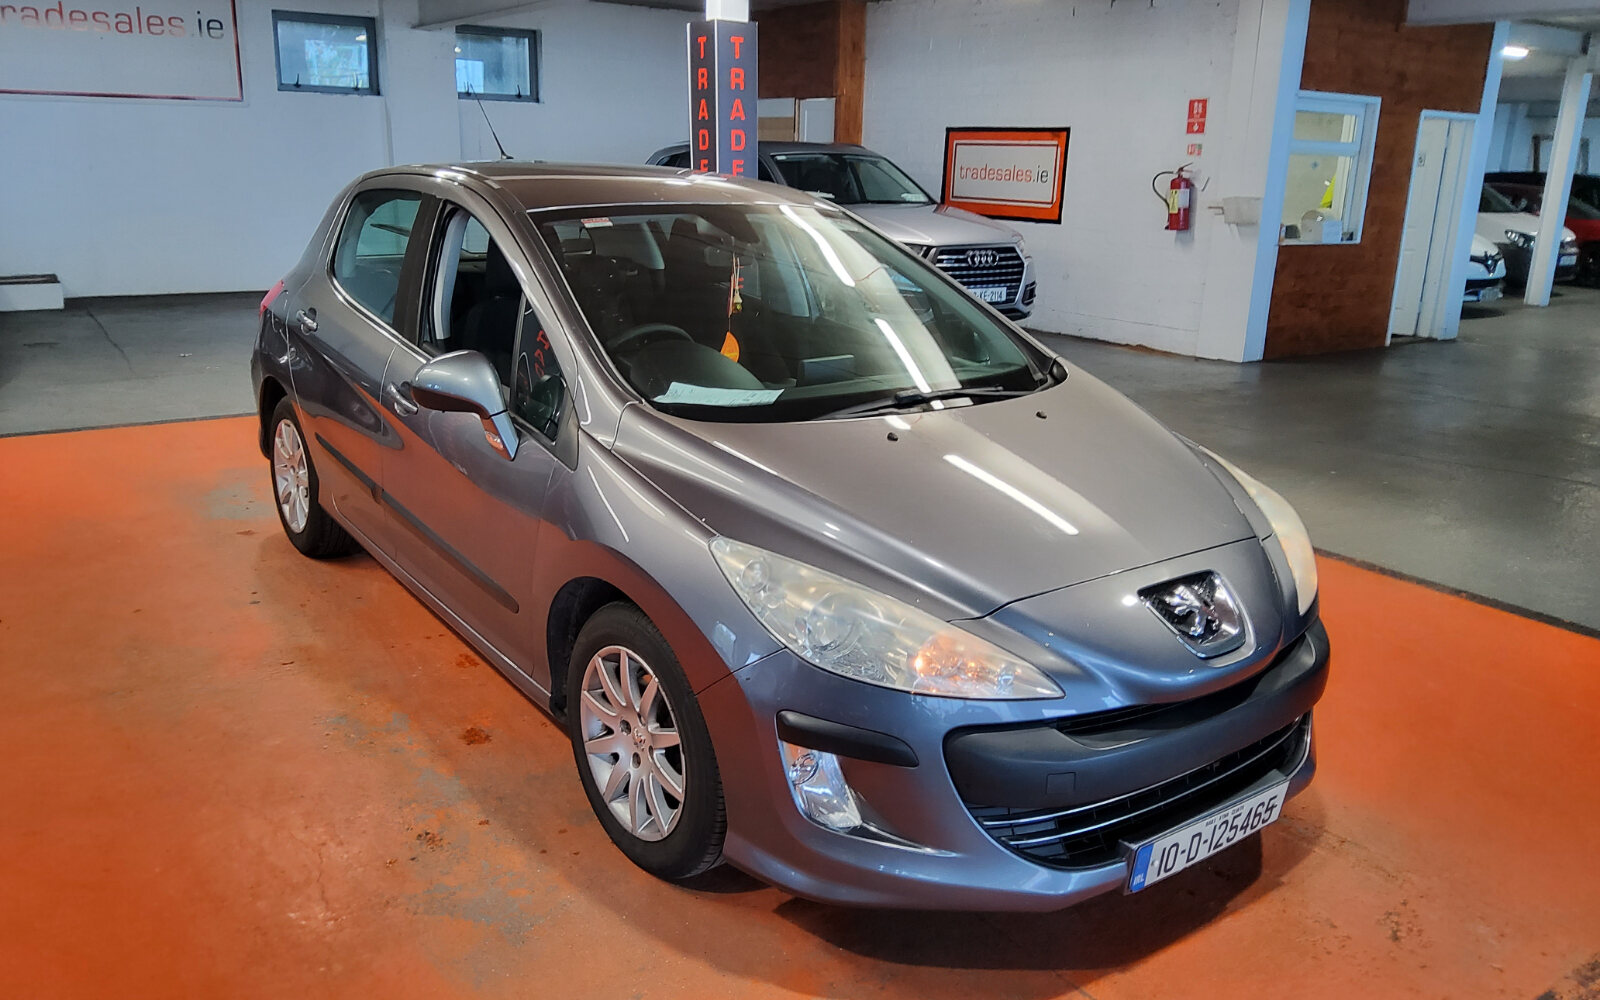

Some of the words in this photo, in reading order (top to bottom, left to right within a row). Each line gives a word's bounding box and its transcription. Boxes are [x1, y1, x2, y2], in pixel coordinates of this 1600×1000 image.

[0, 1, 224, 39] radesales.ie
[959, 164, 1049, 184] tradesales.ie
[1157, 796, 1278, 877] 10-D-125465
